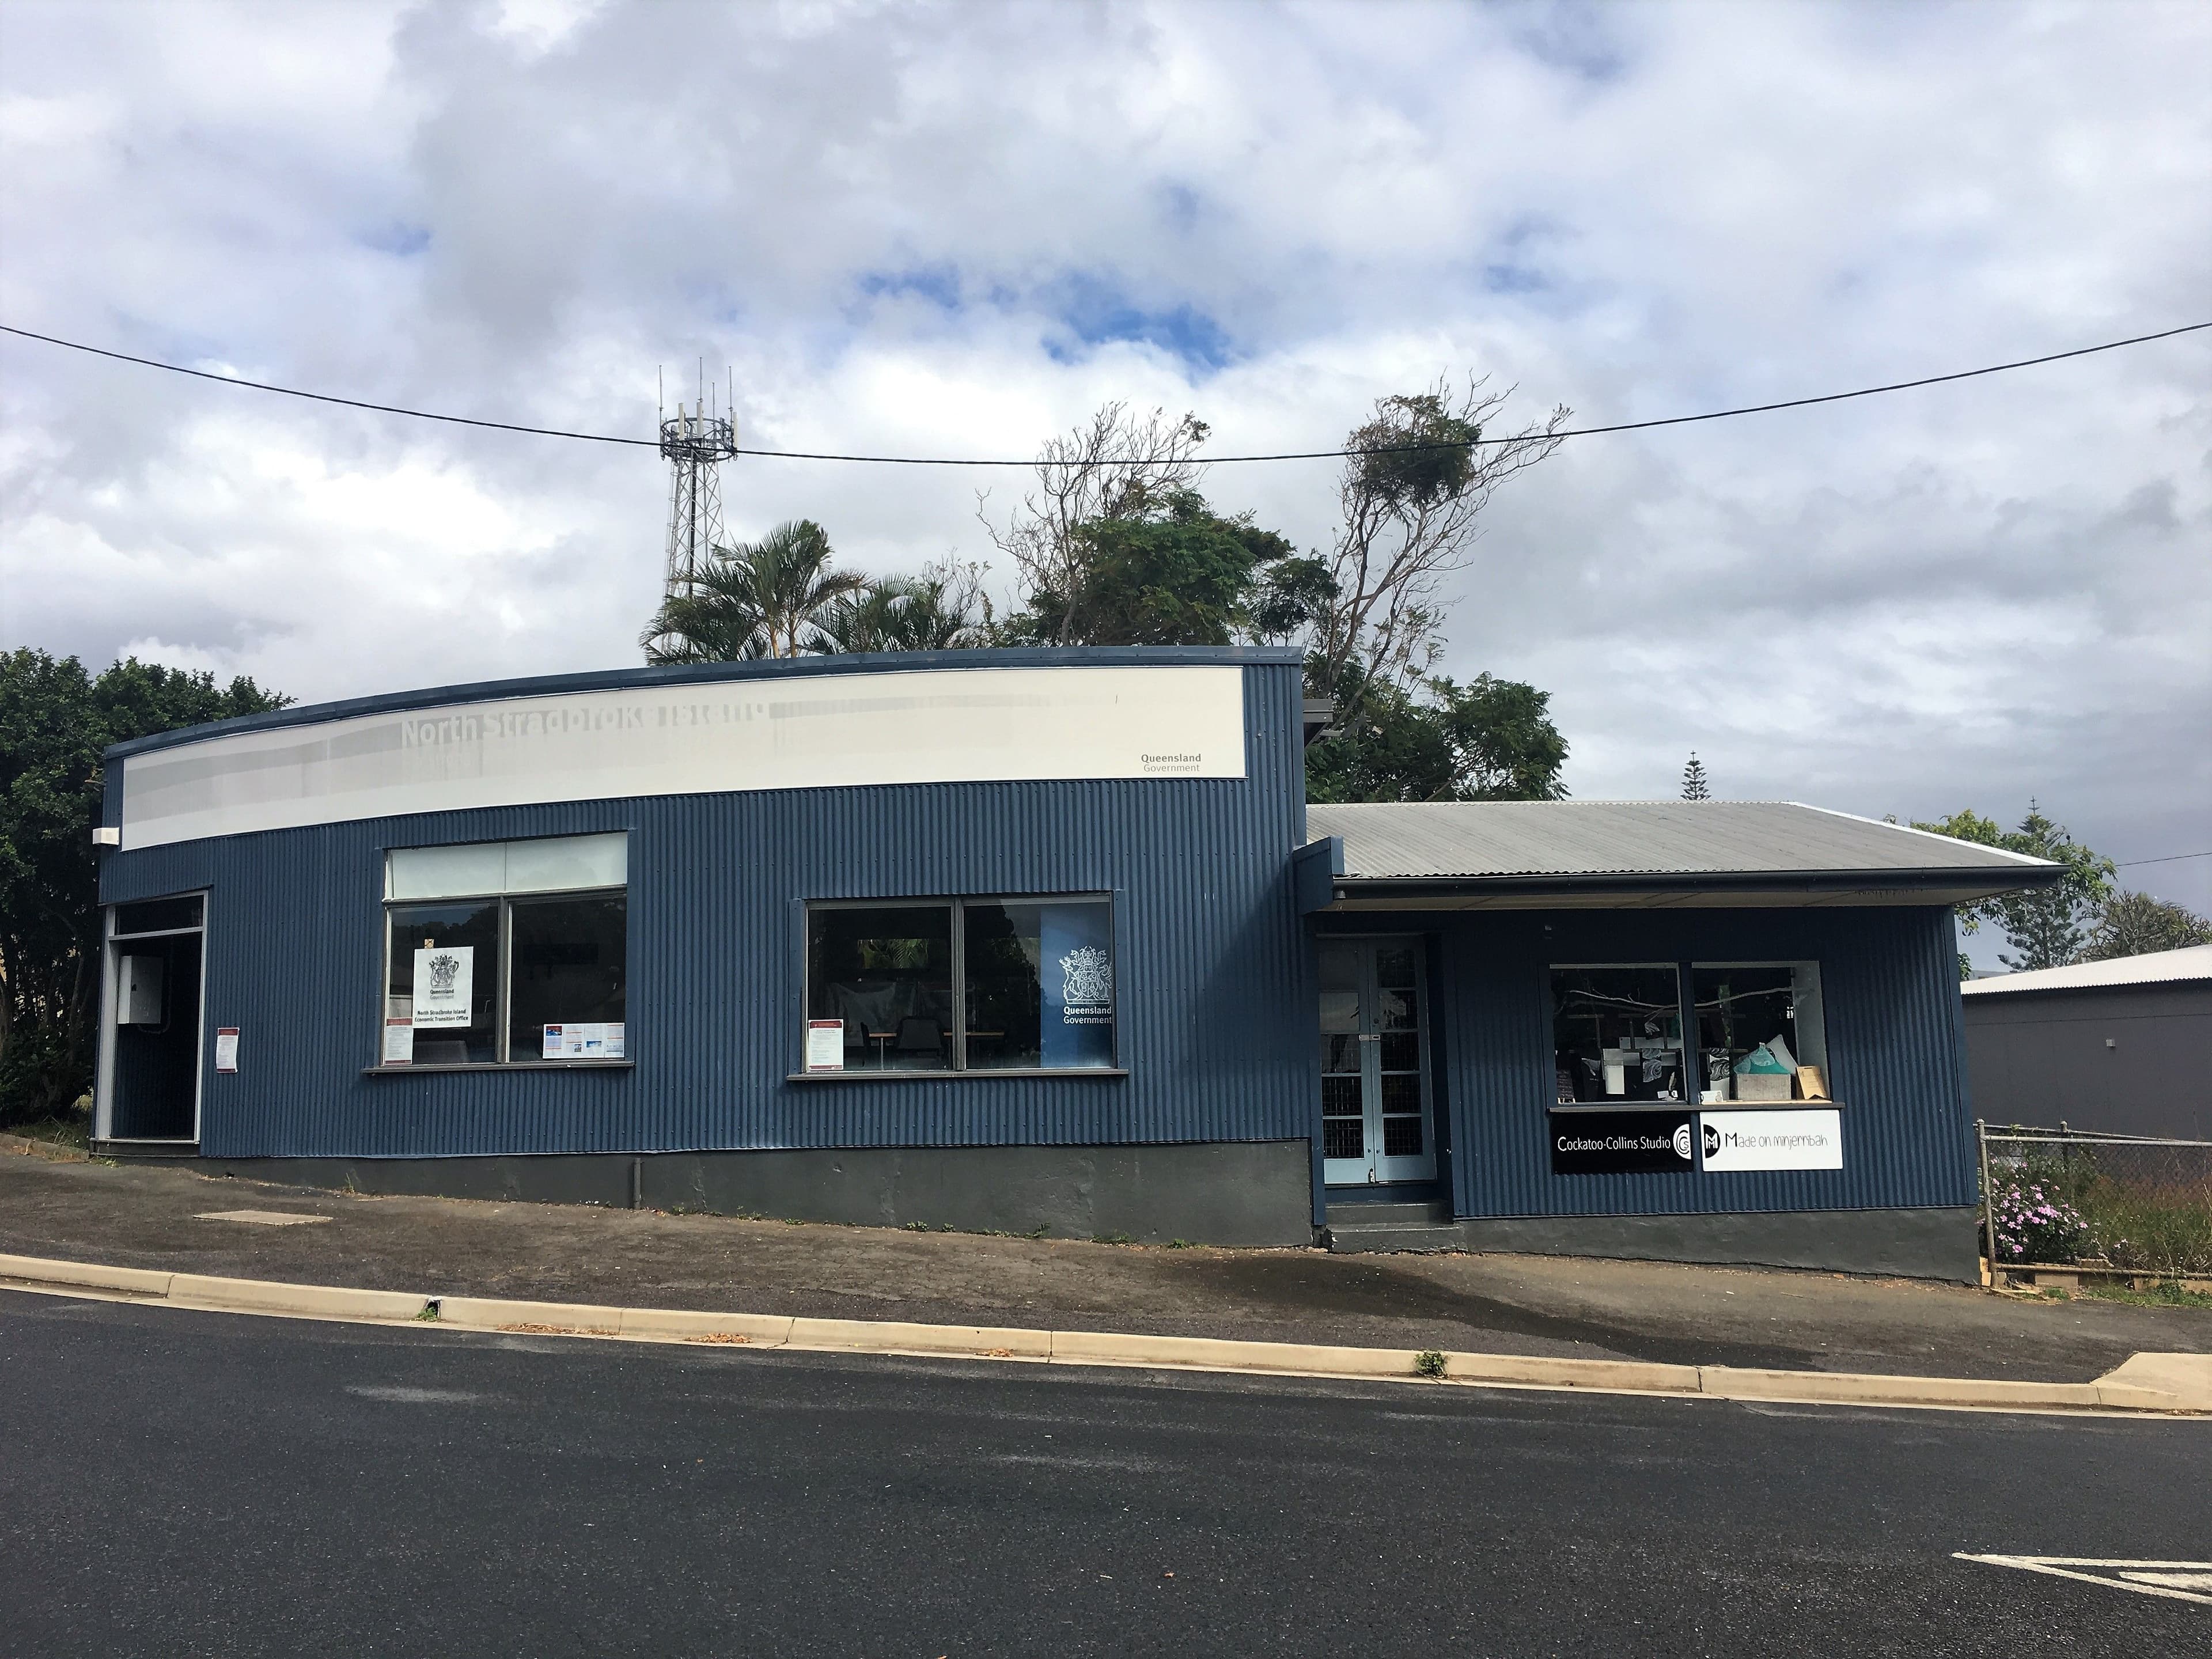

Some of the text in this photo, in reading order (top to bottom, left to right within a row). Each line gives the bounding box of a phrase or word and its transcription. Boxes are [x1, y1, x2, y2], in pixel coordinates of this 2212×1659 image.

[401, 715, 478, 747] North
[1141, 753, 1201, 763] Queensland
[1143, 764, 1200, 772] Government
[1063, 1006, 1111, 1015] Queensland
[1063, 1016, 1112, 1024] Government
[1558, 1136, 1671, 1152] Cockatoo-Collins Studio
[1725, 1132, 1828, 1150] Made on minjerribah
